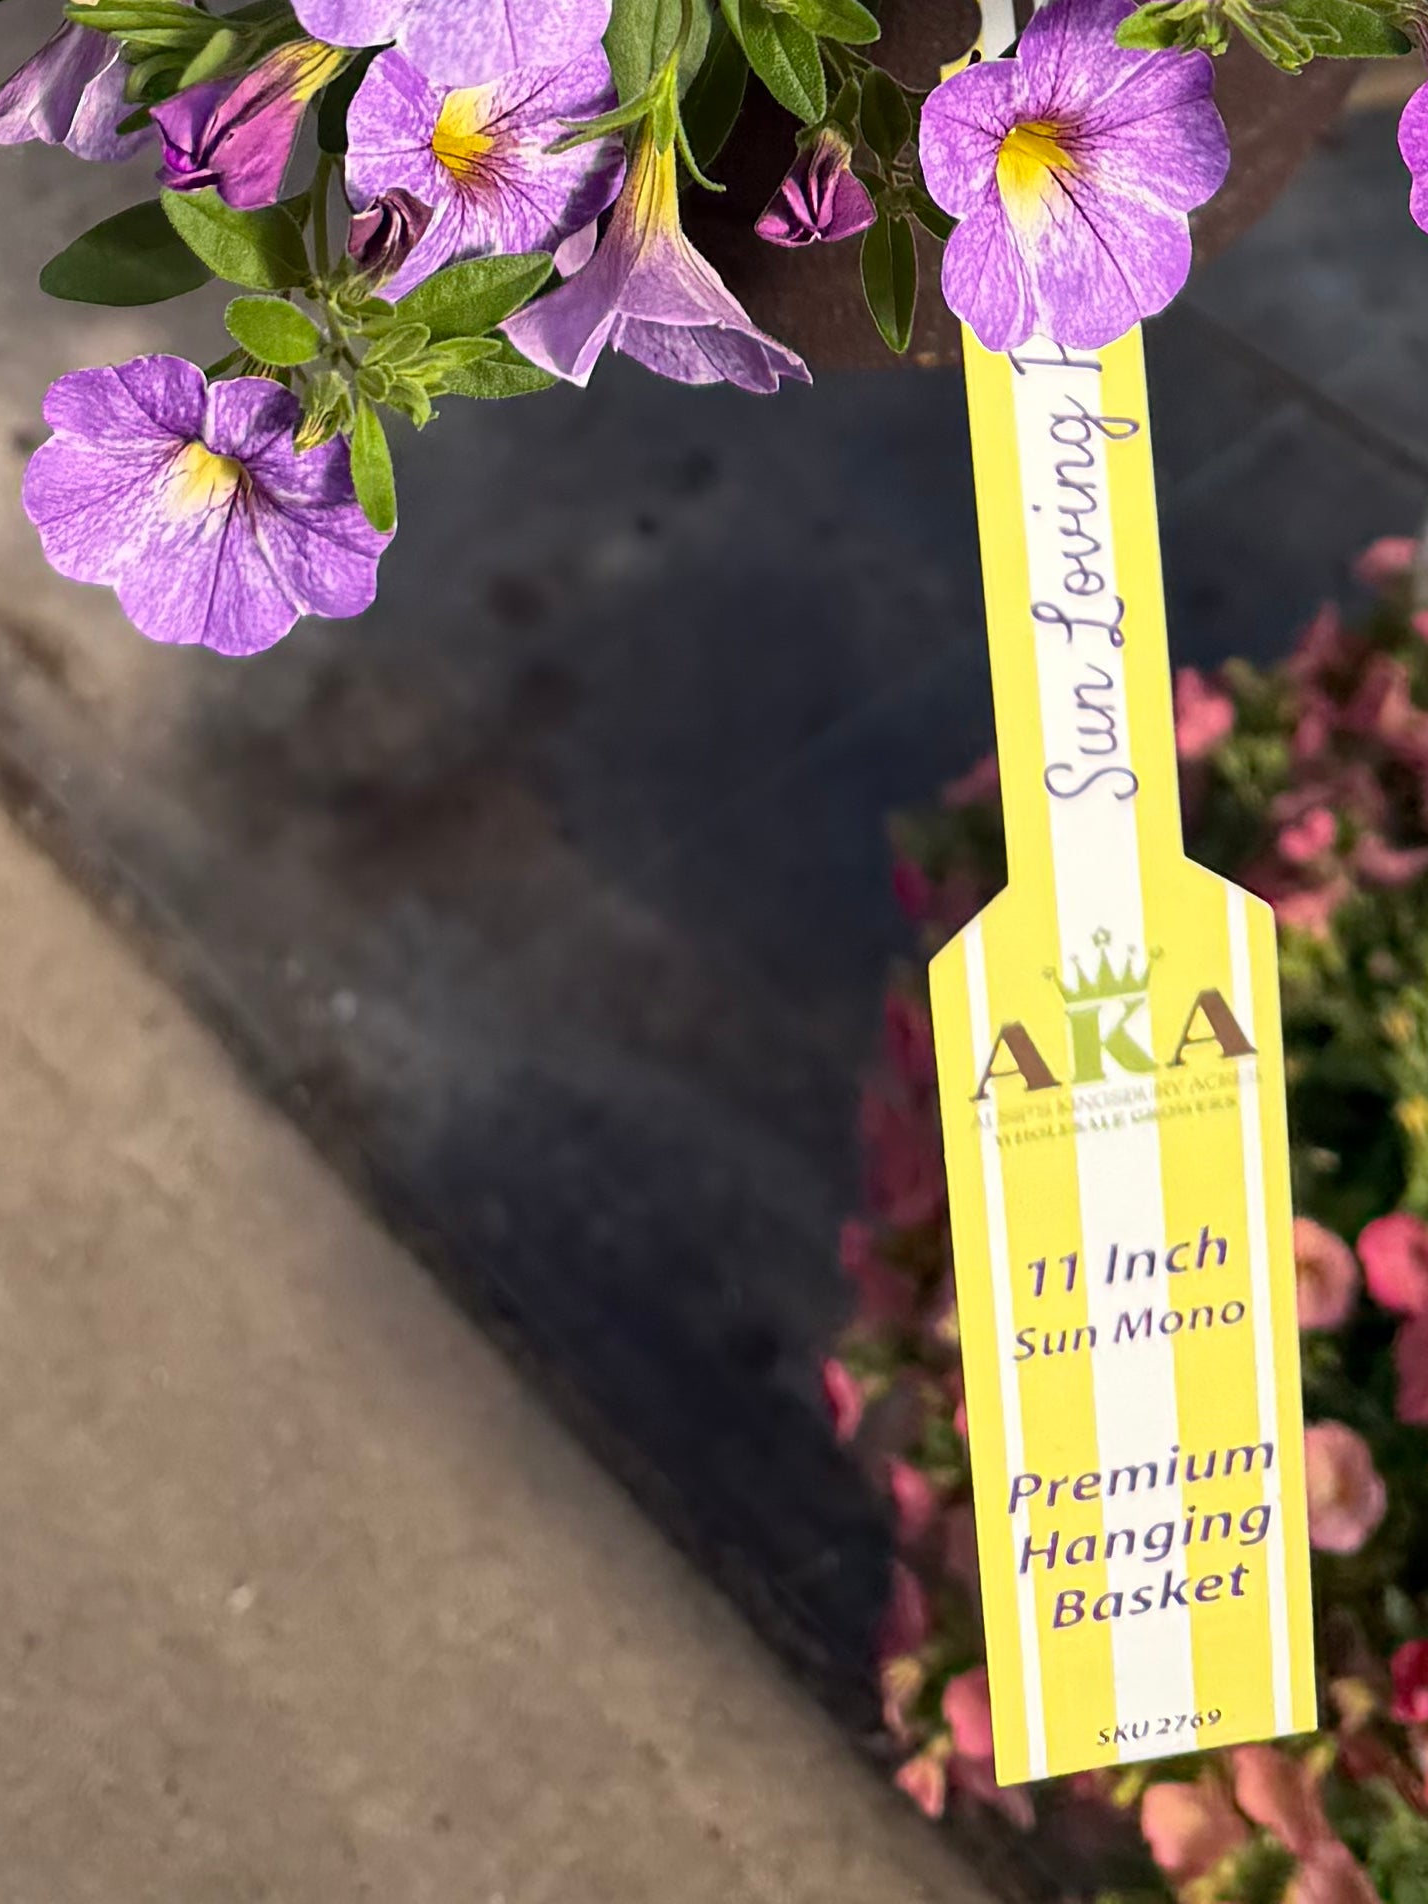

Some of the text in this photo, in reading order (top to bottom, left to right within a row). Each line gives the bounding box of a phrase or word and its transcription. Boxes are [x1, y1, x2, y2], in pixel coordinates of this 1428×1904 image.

[1031, 394, 1141, 648] Loving
[1043, 663, 1140, 801] Sun
[969, 987, 1259, 1103] AKA
[1028, 1225, 1228, 1297] 11 Inch
[1012, 1299, 1245, 1362] Sun Mono
[1008, 1441, 1274, 1514] Premium
[1019, 1504, 1271, 1574] Hanging
[1053, 1562, 1250, 1629] Basket
[1096, 1708, 1222, 1747] SKU 2769
